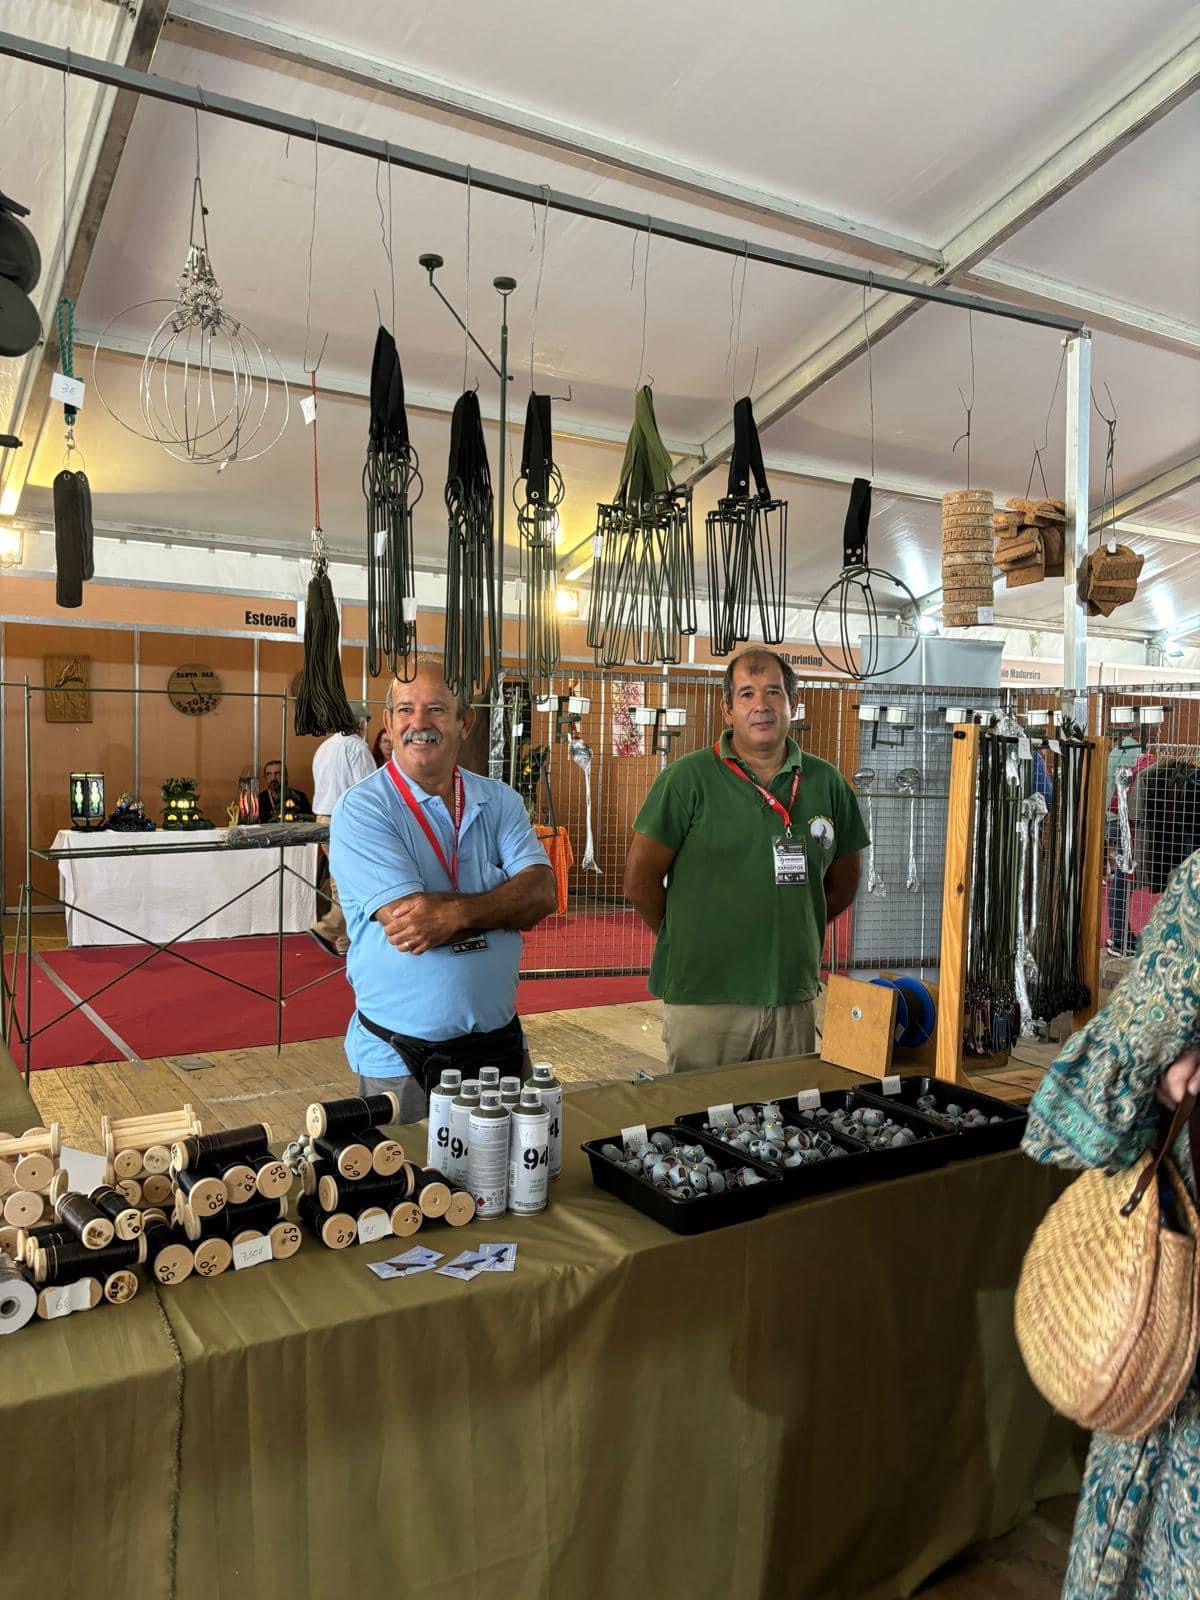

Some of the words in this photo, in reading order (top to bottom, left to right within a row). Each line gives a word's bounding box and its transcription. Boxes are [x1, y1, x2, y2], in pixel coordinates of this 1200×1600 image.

[245, 610, 296, 628] Estevão
[1010, 669, 1040, 680] Madureira
[437, 1126, 450, 1148] 9
[451, 1137, 469, 1160] 9
[523, 1145, 549, 1170] 94
[270, 1165, 287, 1179] 50
[245, 1173, 257, 1192] 50
[208, 1193, 224, 1210] 50
[283, 1227, 299, 1242] 50
[159, 1265, 176, 1282] 50
[200, 1261, 217, 1276] 50
